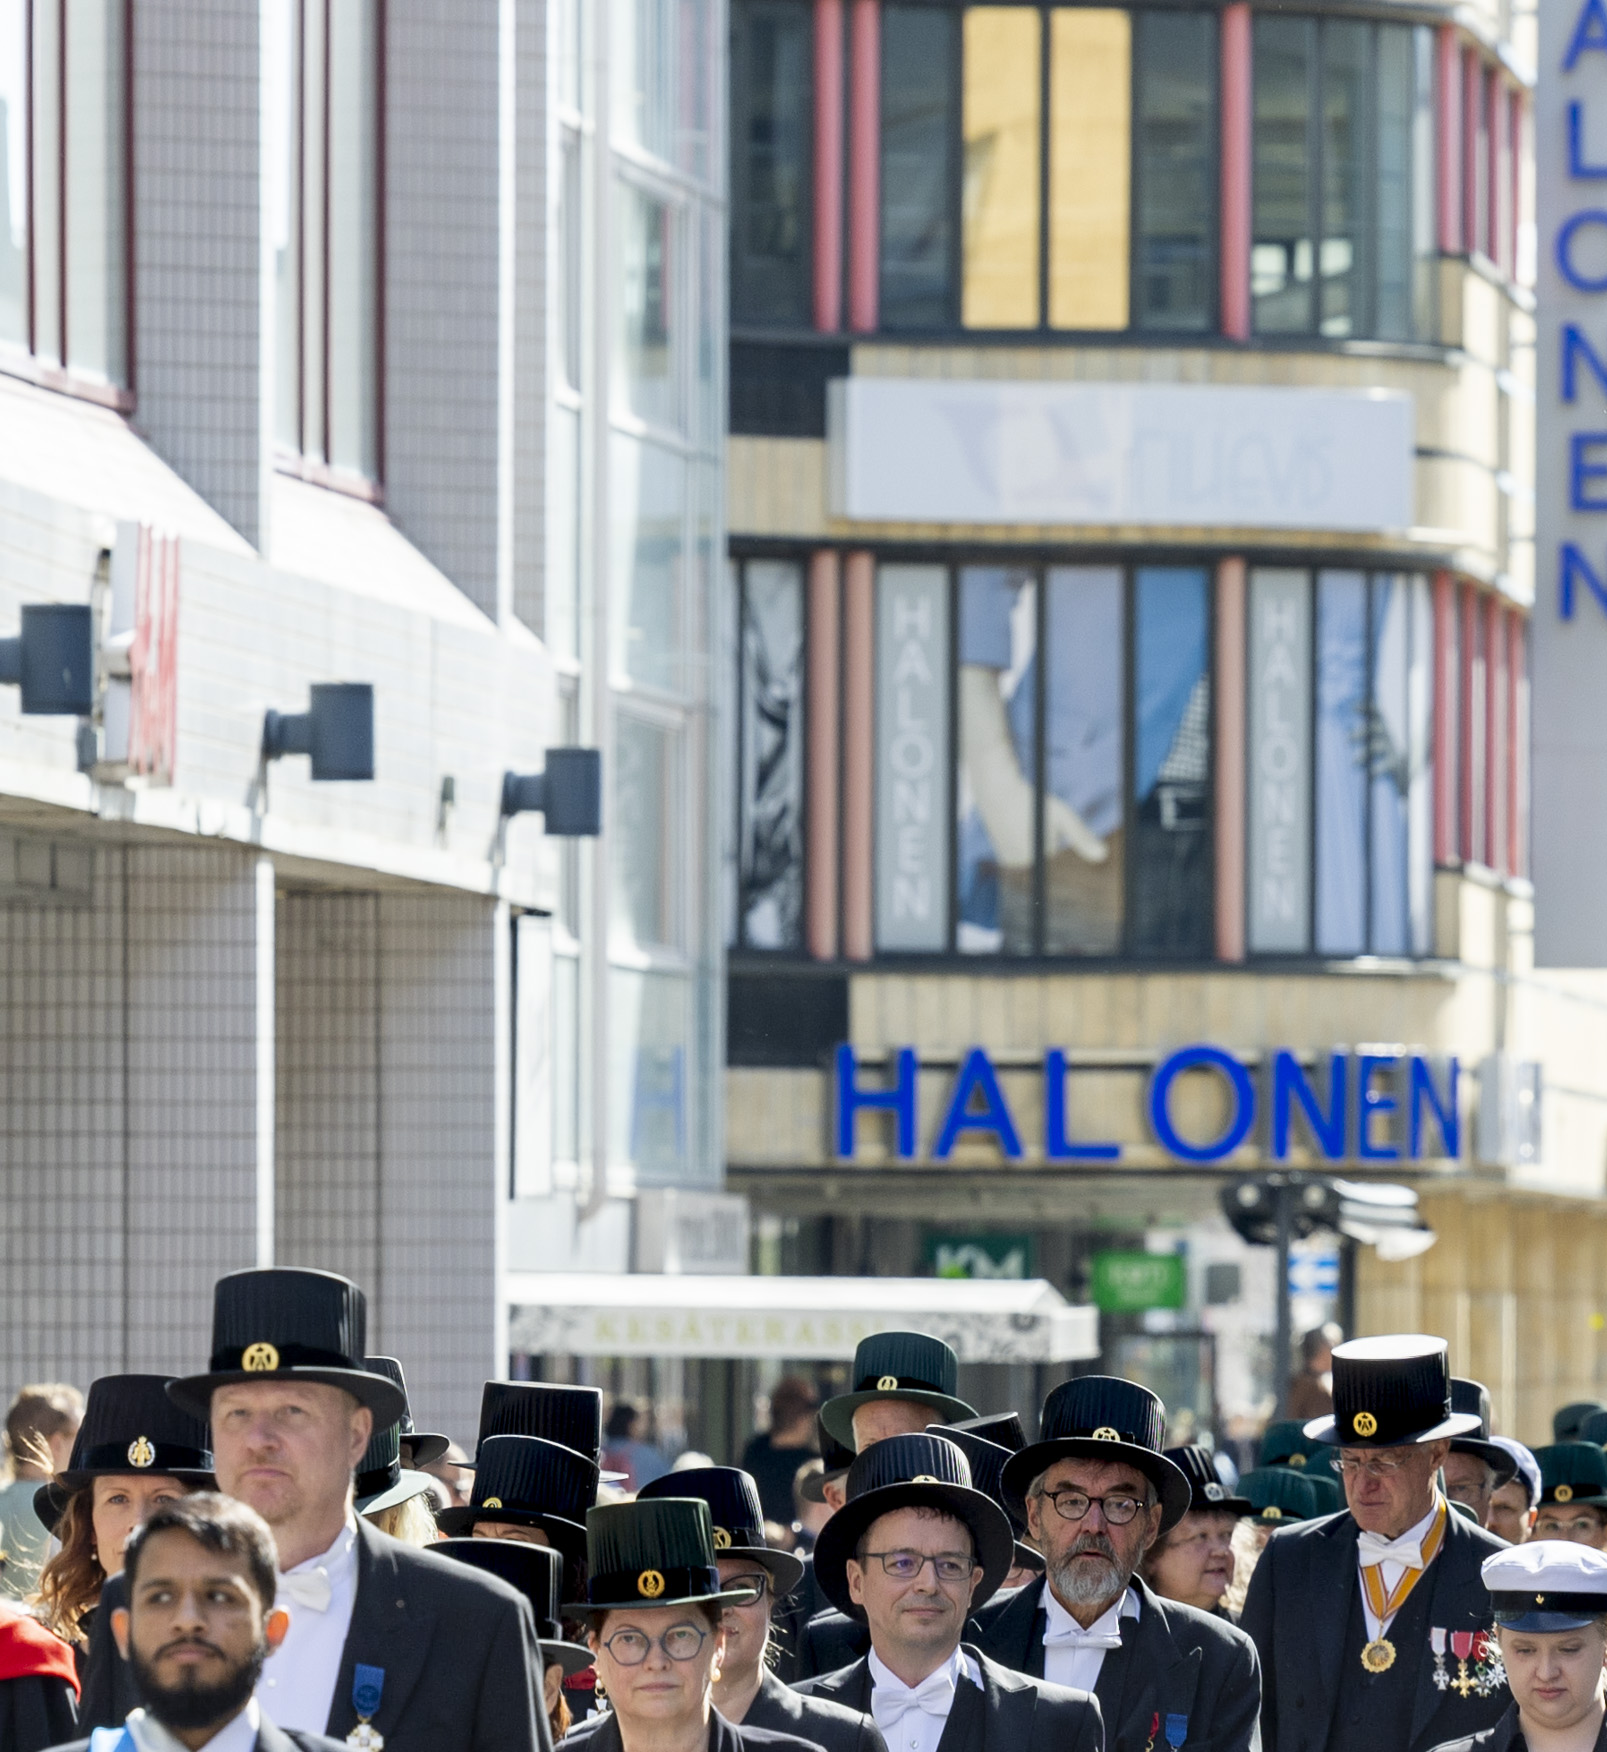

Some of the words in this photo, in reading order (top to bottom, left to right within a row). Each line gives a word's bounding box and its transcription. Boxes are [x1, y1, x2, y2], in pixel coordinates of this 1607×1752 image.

[890, 596, 934, 918] HALONEN
[1258, 597, 1298, 921] HALONEN
[833, 1043, 1462, 1163] HALONEN
